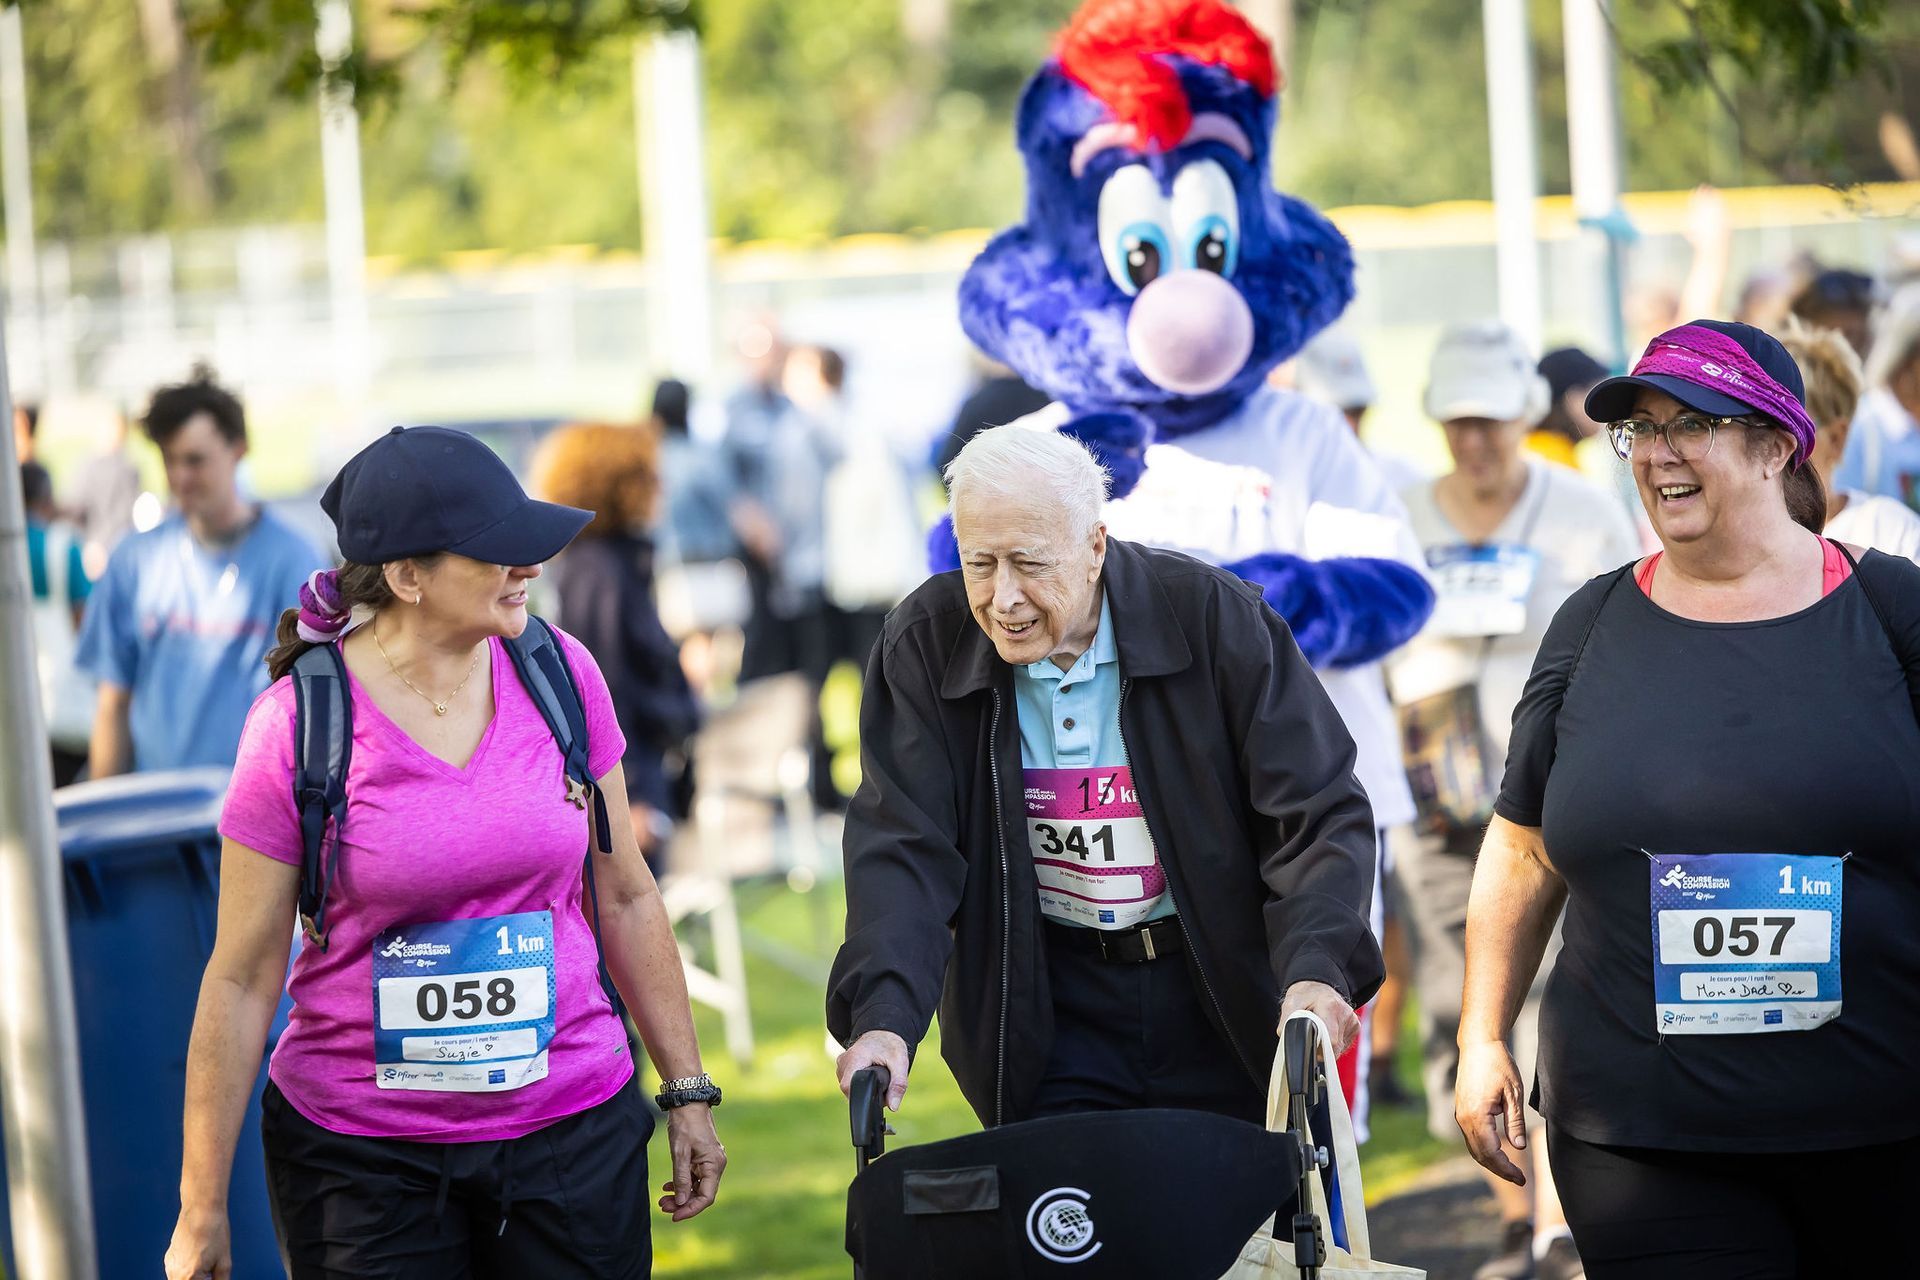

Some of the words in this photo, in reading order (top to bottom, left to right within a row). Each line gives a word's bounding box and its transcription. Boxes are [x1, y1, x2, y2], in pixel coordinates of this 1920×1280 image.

[1035, 823, 1115, 861] 341
[1682, 875, 1712, 883] COURSE
[1778, 865, 1796, 895] 1
[1801, 876, 1832, 896] km
[496, 926, 513, 955] 1
[517, 934, 545, 953] km
[1693, 916, 1796, 958] 057
[416, 977, 516, 1022] 058
[1675, 1013, 1696, 1026] Pfizer
[436, 1046, 481, 1062] Suzie
[397, 1070, 420, 1082] Pfizer
